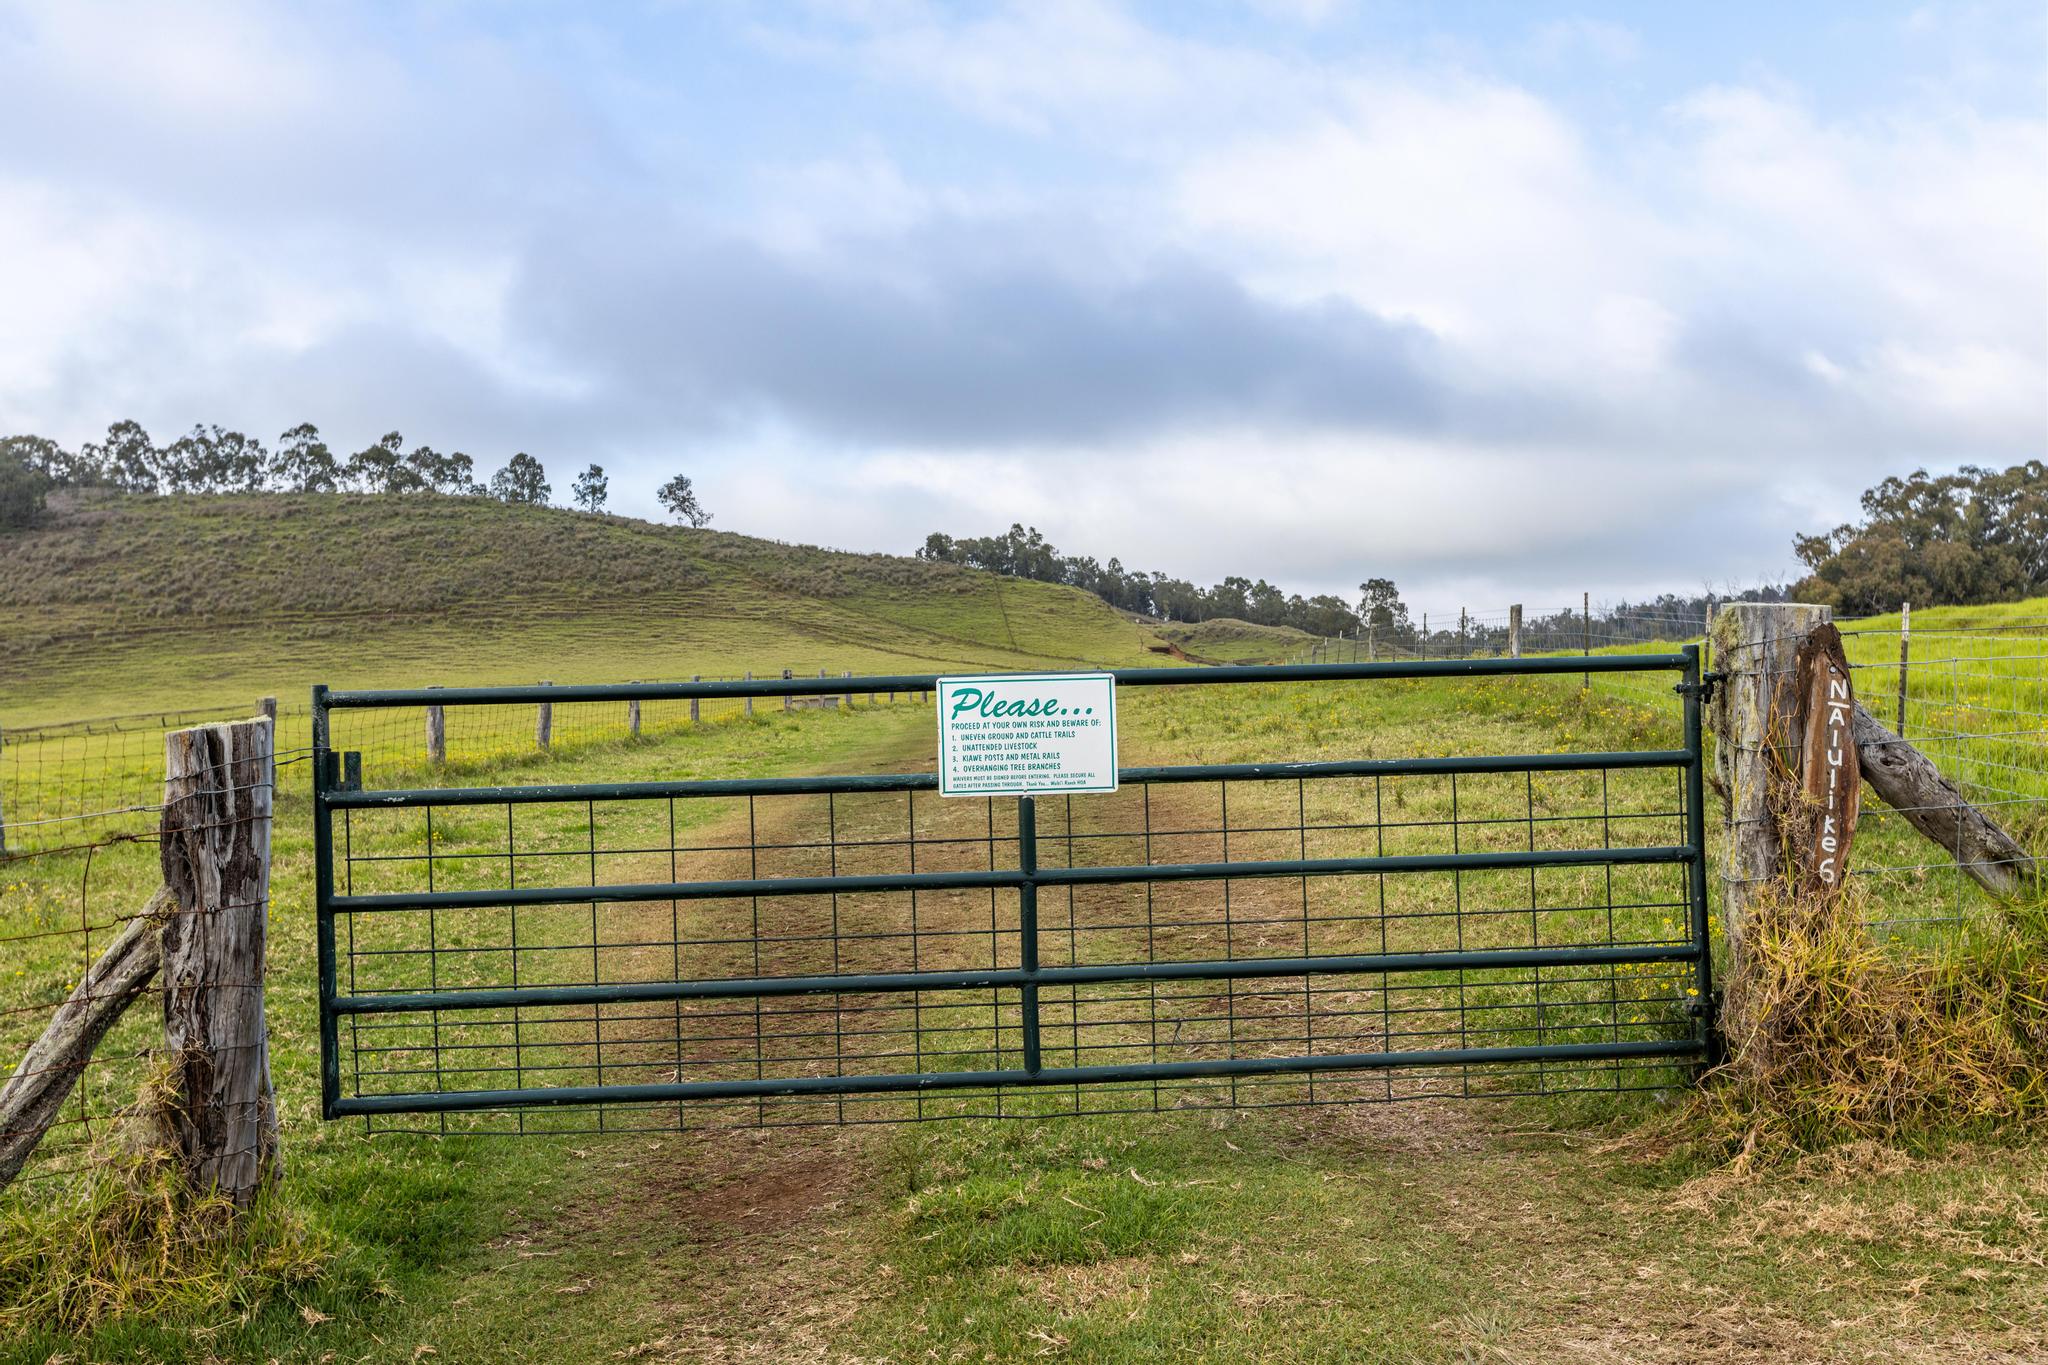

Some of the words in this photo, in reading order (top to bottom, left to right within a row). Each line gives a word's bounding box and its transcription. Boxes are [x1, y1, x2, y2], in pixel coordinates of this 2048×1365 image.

[951, 688, 1093, 720] Please...
[952, 722, 980, 730] PROCEED
[992, 721, 1010, 729] YOUR
[1063, 719, 1088, 727] BEWARE
[1004, 742, 1037, 750] LIVESTOCK
[964, 764, 1008, 772] OVERHANGING
